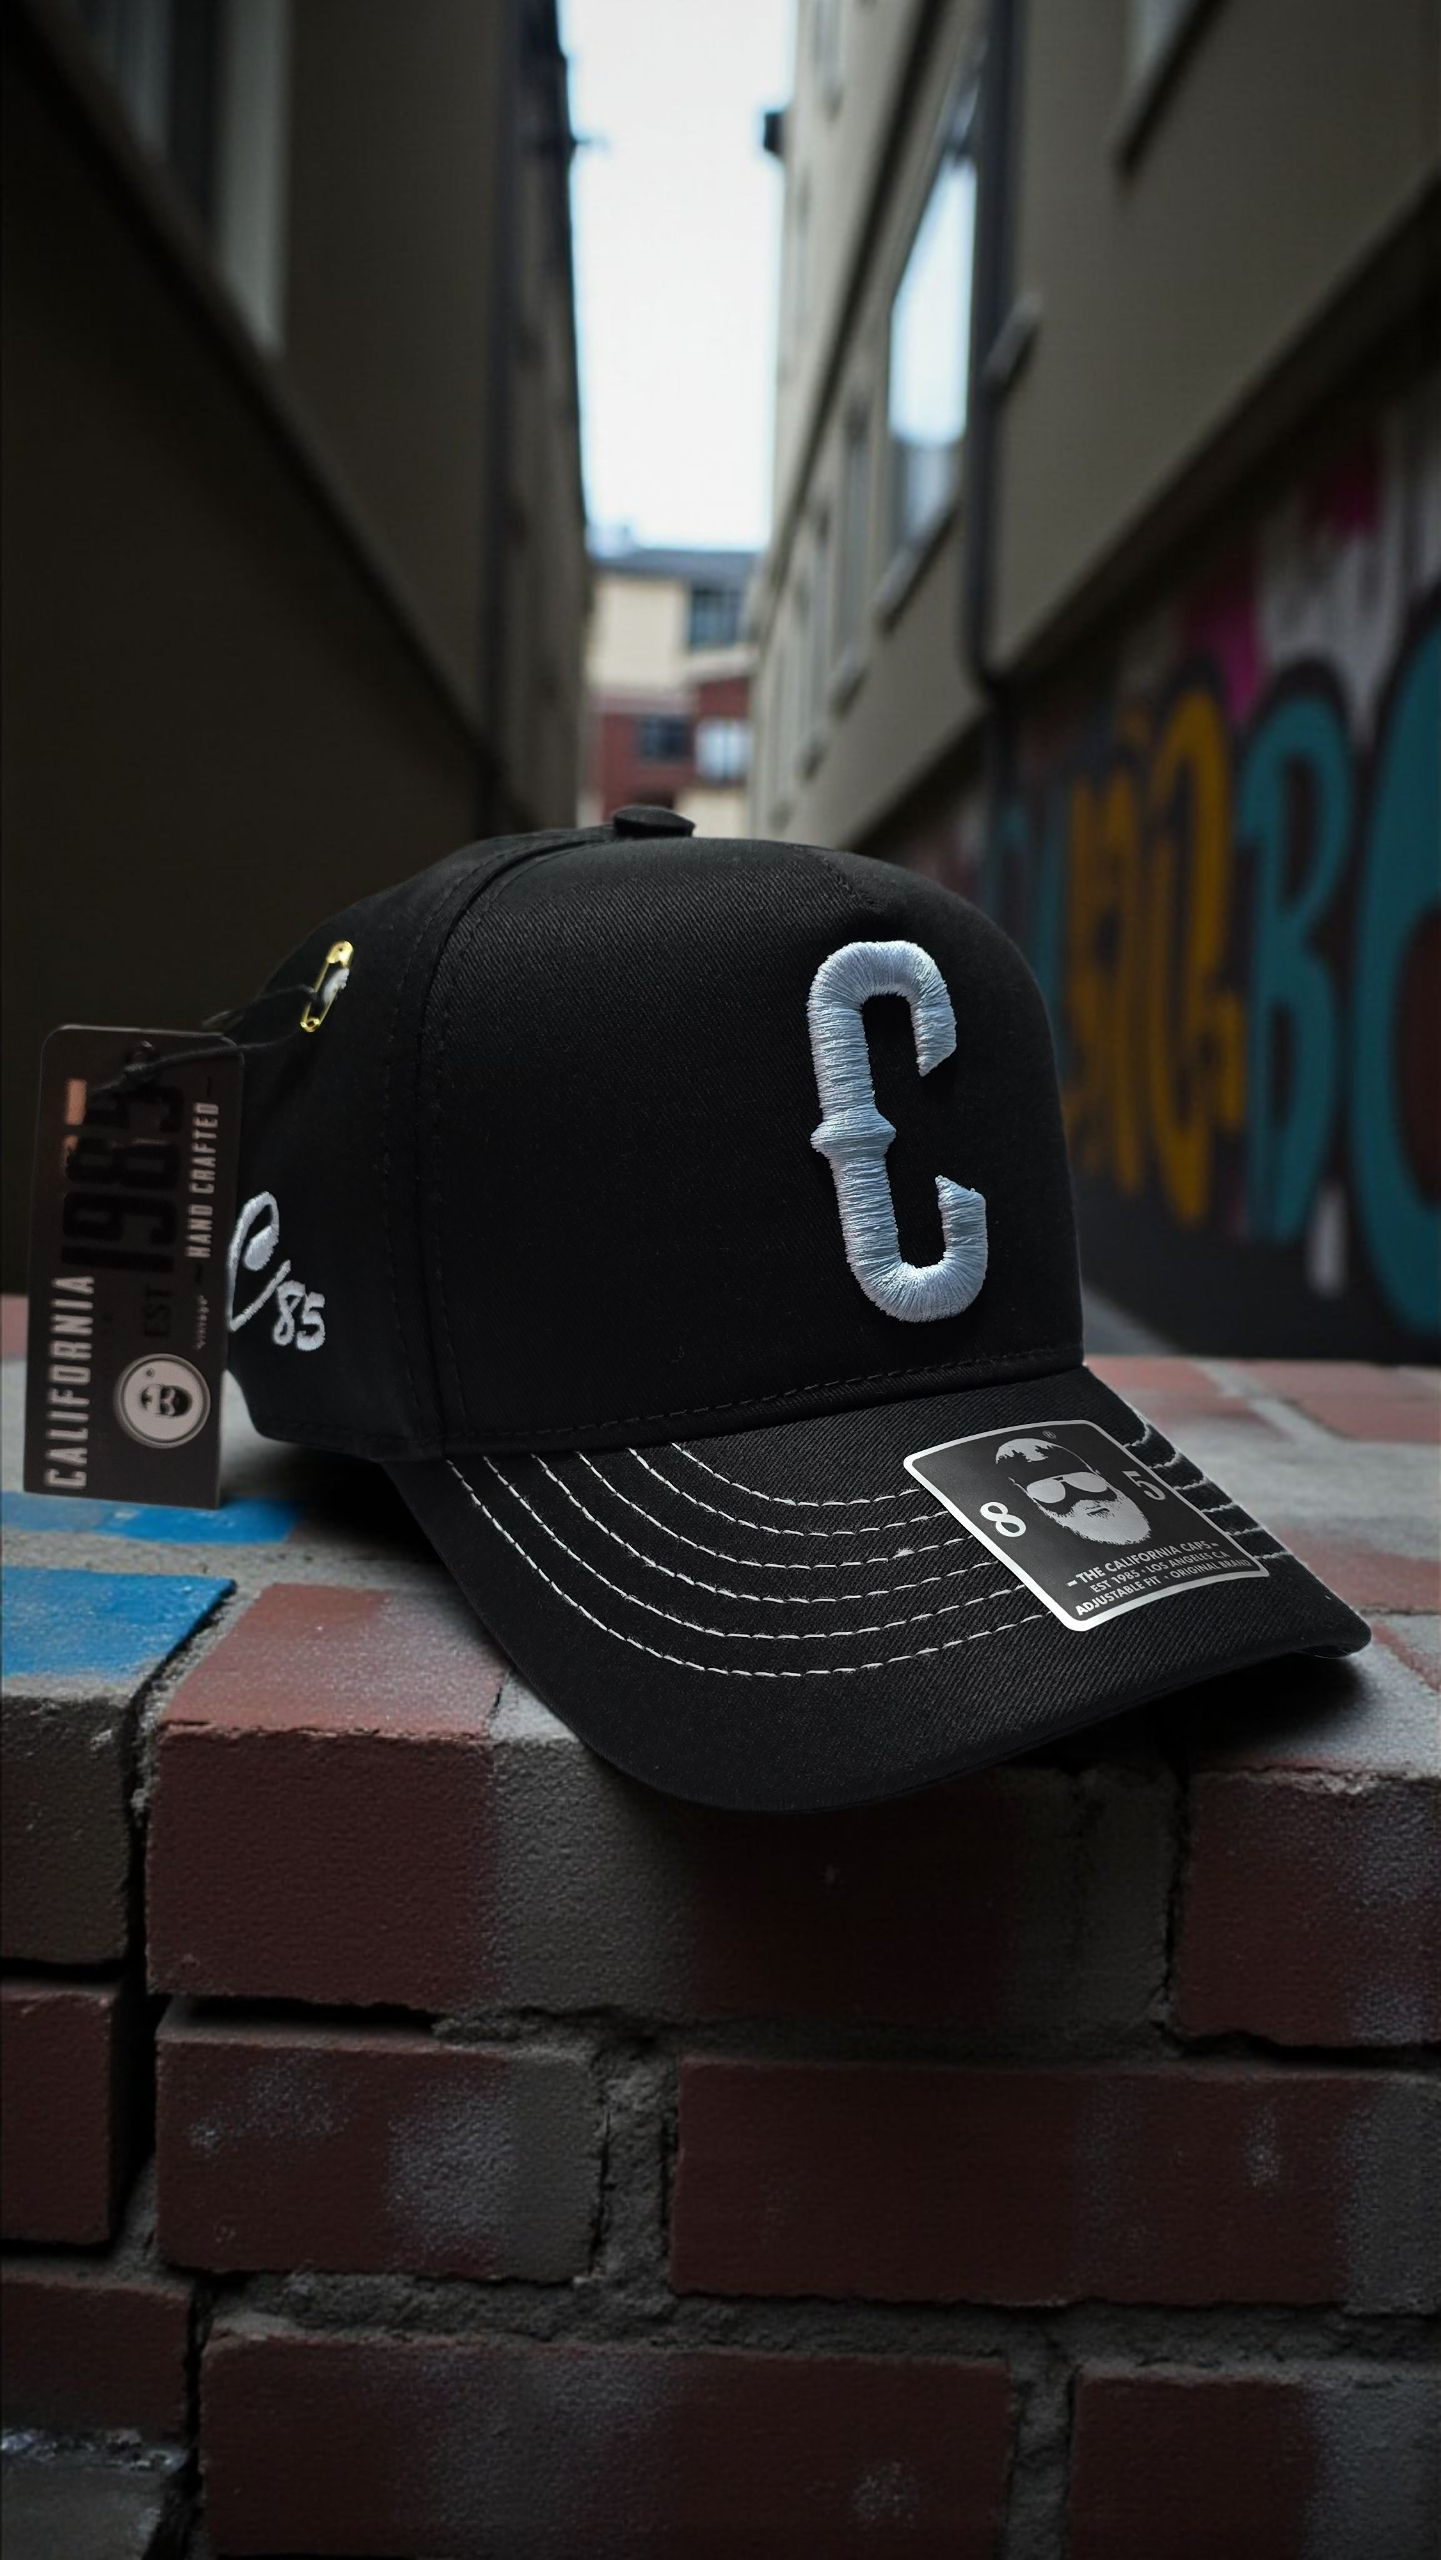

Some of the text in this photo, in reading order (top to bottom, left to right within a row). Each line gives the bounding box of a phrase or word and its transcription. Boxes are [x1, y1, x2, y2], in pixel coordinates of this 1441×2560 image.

[807, 940, 989, 1323] C
[60, 1078, 184, 1274] 1985
[184, 1101, 220, 1259] HAND CRAFTED
[140, 1282, 172, 1339] EST
[42, 1275, 95, 1491] CALIFORNIA
[1121, 1469, 1167, 1501] 5
[980, 1500, 1027, 1538] 8
[1075, 1540, 1210, 1584] THE CALIFORNIA CAPS
[1075, 1558, 1253, 1616] ADJUSTABLE FIT ORIGINAL BRAND
[1090, 1579, 1112, 1593] EST
[1111, 1569, 1141, 1584] 1985
[1145, 1561, 1169, 1573] LOS
[1168, 1552, 1214, 1568] ANGELES
